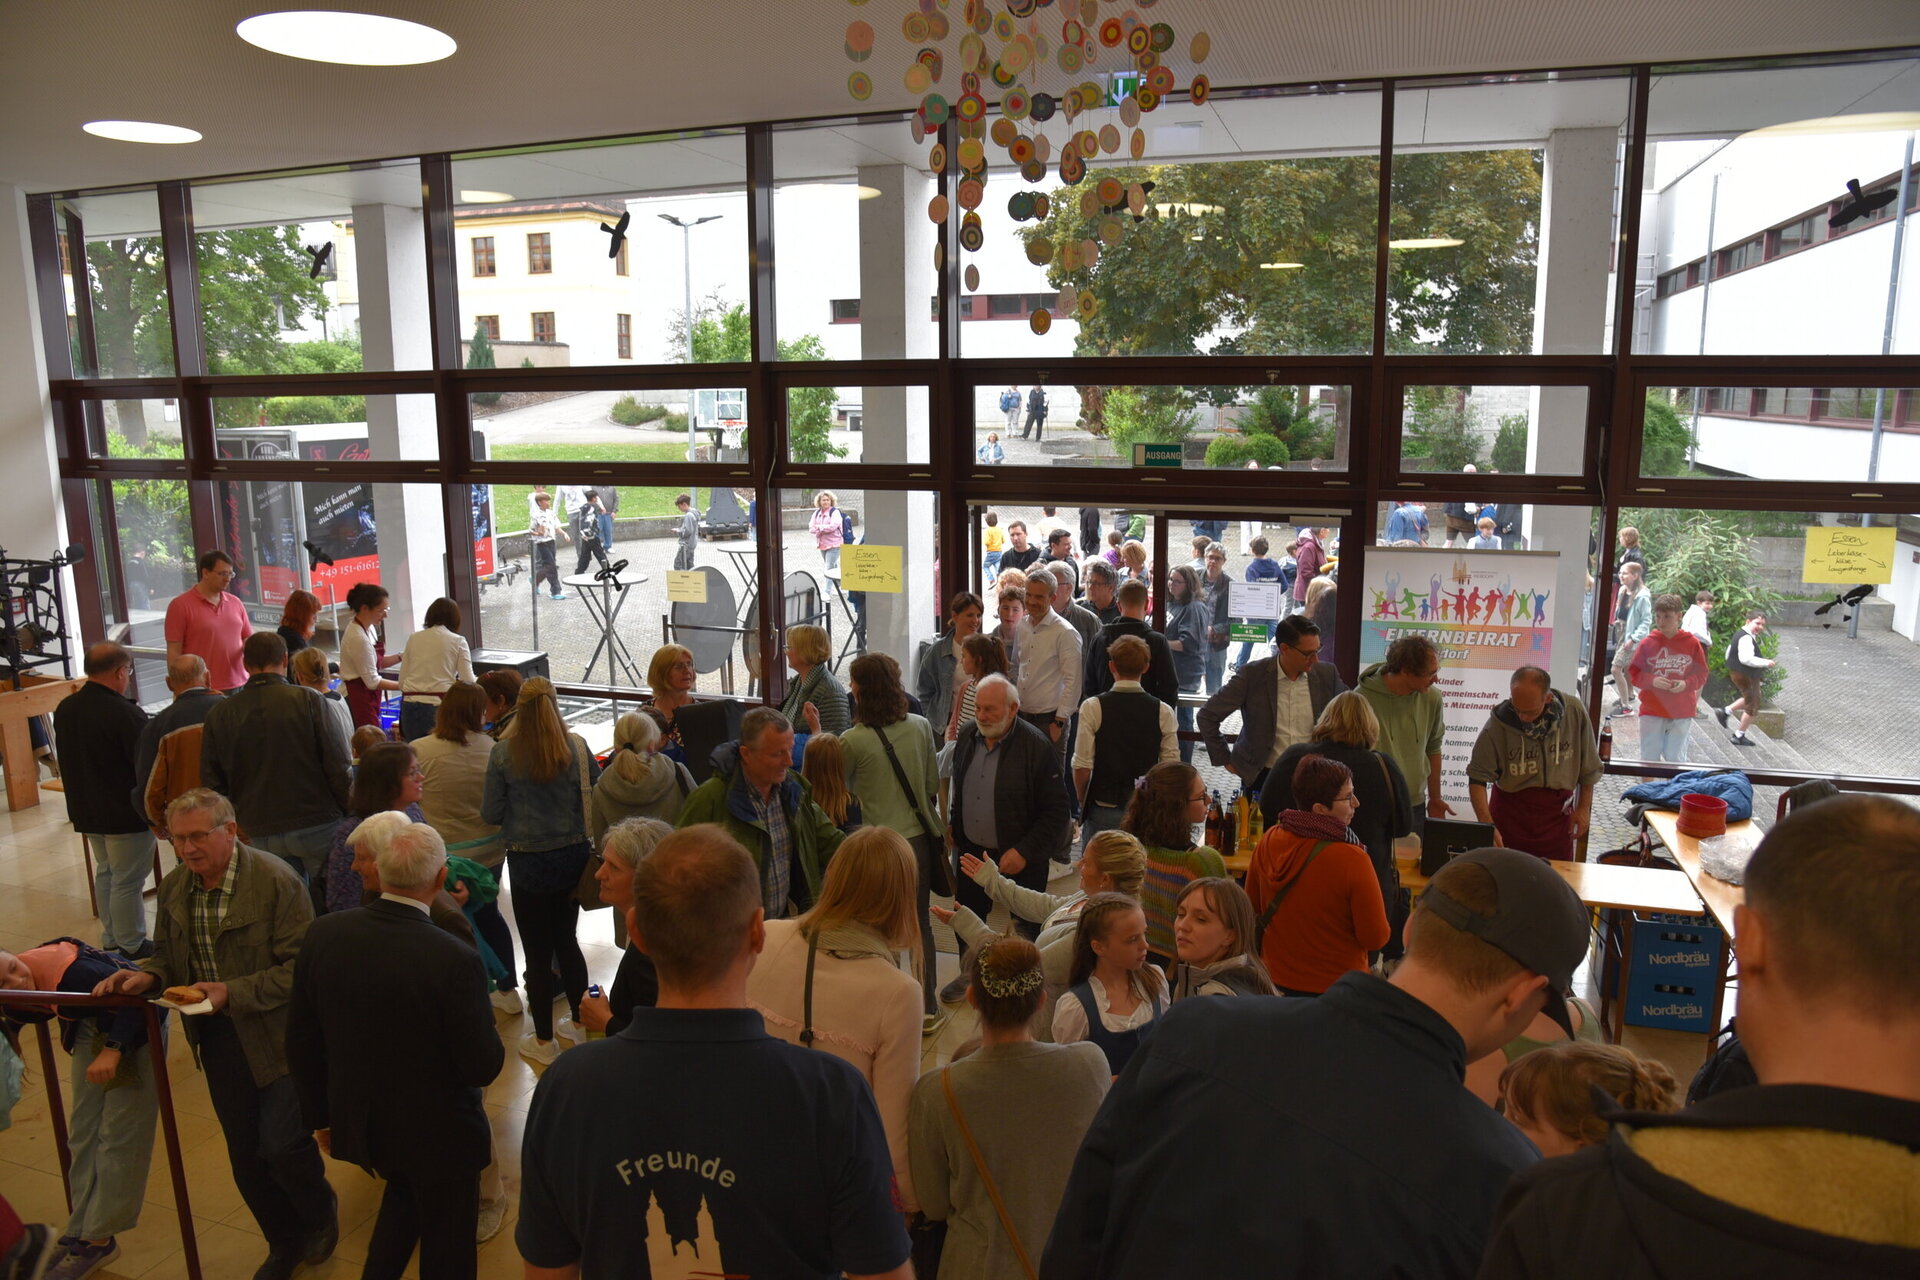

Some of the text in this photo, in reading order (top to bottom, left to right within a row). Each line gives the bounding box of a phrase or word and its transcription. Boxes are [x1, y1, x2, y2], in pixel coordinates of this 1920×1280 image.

[1145, 451, 1181, 460] AUSGANG
[313, 484, 362, 515] Mich kann man
[318, 501, 354, 525] auch mieten
[1830, 532, 1865, 545] Essen
[854, 548, 882, 561] Essen
[319, 568, 338, 577] +49
[1441, 690, 1500, 699] gemeinschaft
[1450, 701, 1496, 710] Miteinand
[1445, 725, 1479, 733] estalten
[1444, 739, 1475, 747] komme
[1448, 769, 1468, 777] schu
[1648, 950, 1711, 965] Nordbräu
[1641, 1002, 1703, 1016] Nordbräu
[615, 1151, 736, 1188] Freunde
